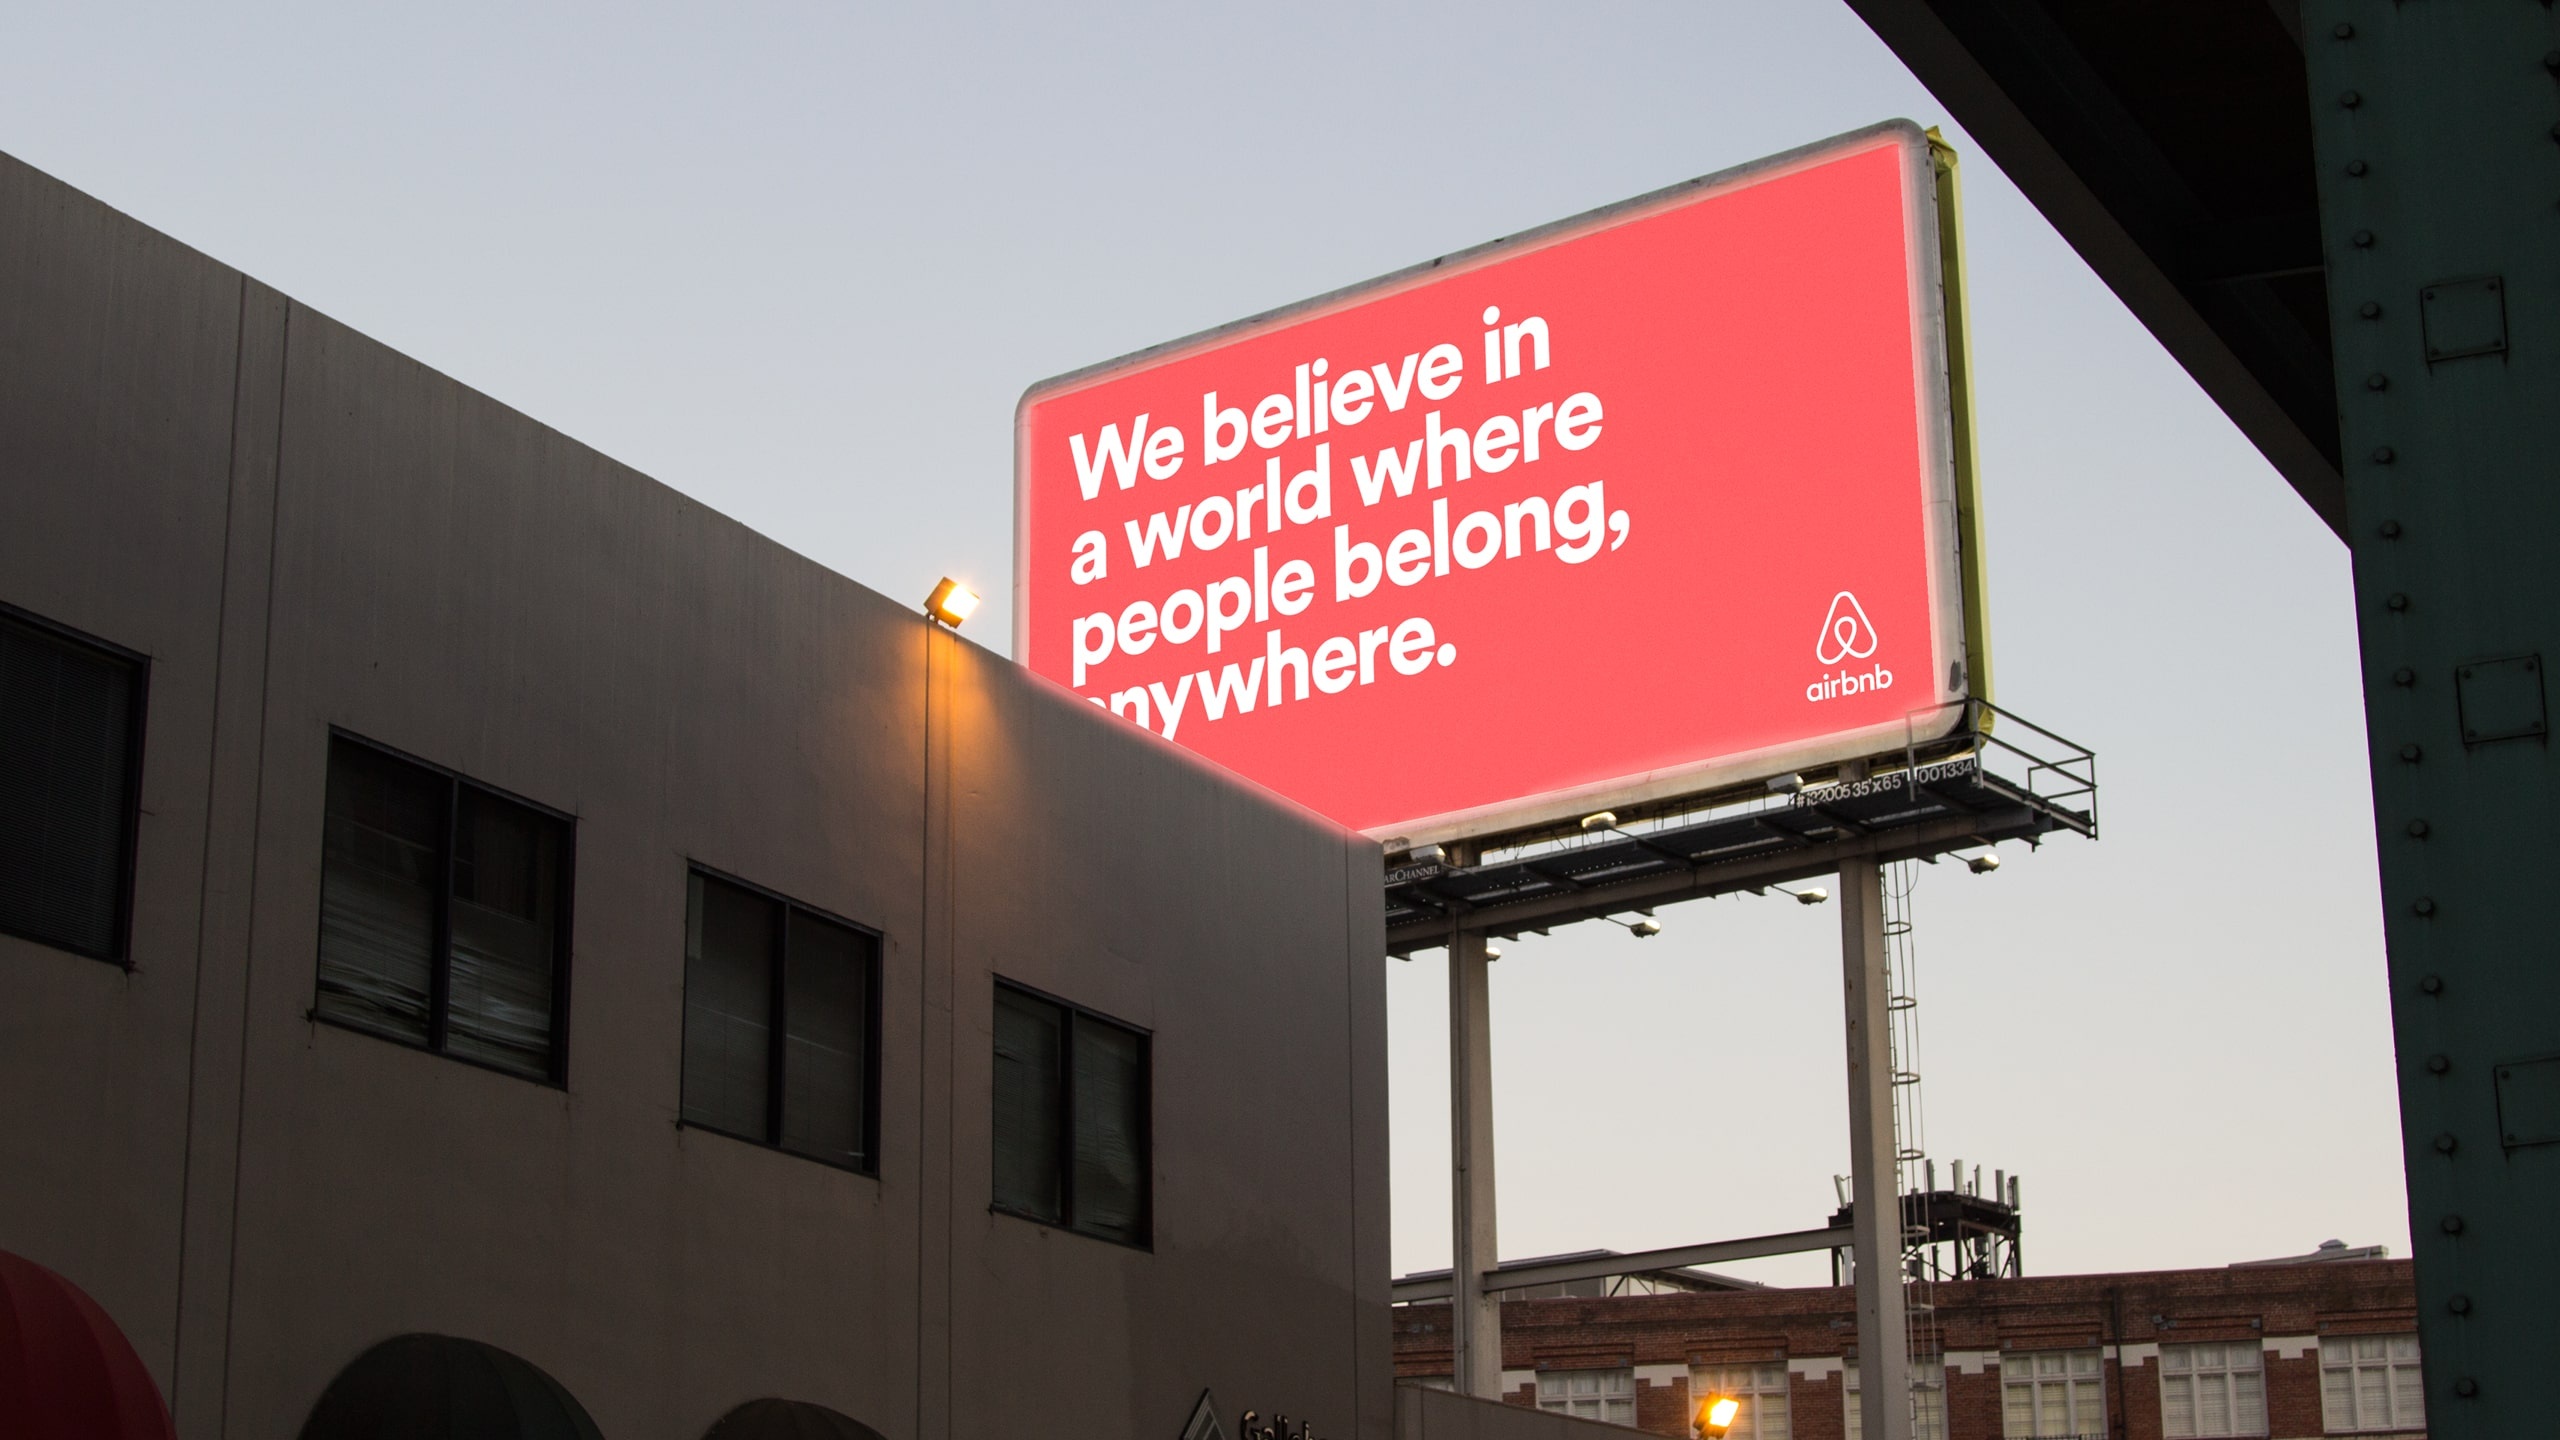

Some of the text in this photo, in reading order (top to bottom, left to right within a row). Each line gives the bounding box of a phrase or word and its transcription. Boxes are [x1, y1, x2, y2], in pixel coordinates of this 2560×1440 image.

[1068, 305, 1551, 501] We believe in
[1070, 391, 1604, 586] a world where
[1072, 480, 1631, 688] people belong,
[1085, 617, 1457, 742] nywhere.
[1806, 663, 1893, 702] airbnb
[1918, 760, 1973, 784] 001334
